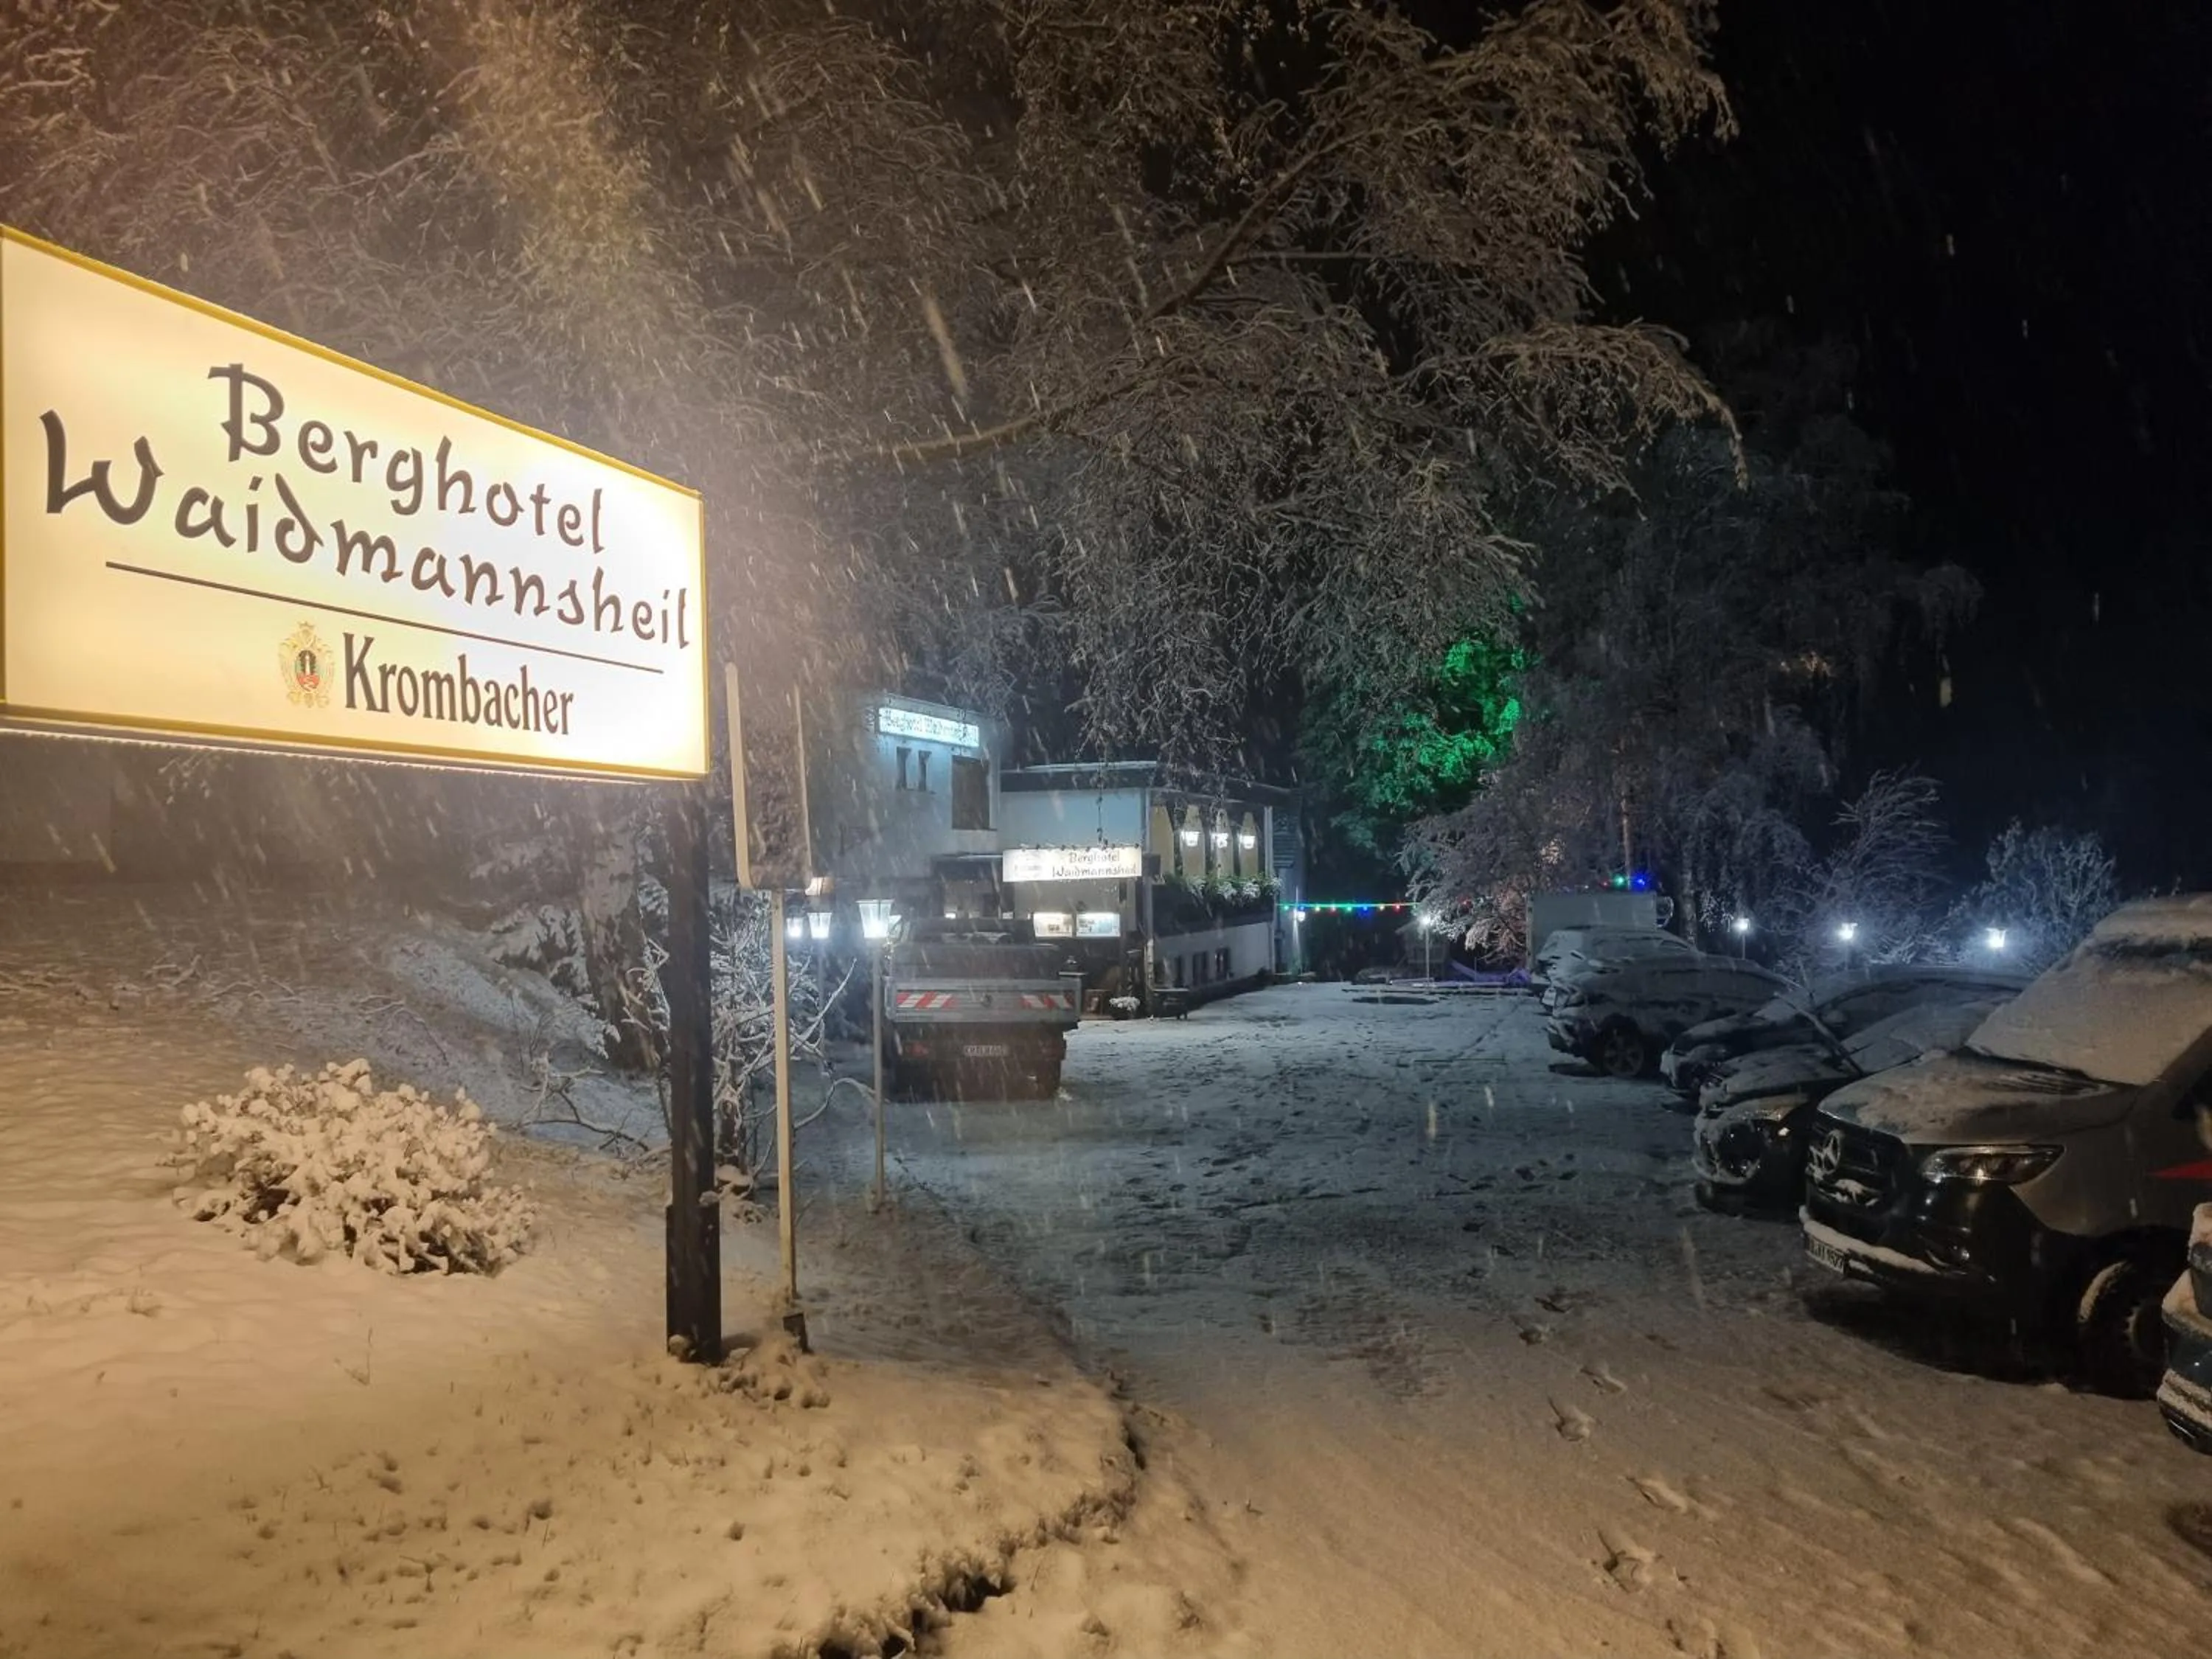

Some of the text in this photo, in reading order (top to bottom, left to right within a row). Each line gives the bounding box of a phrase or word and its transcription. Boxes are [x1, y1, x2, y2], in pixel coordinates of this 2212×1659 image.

[39, 409, 689, 650] Waidmannsheil
[208, 363, 603, 554] Berghotel
[343, 632, 574, 735] Krombacher
